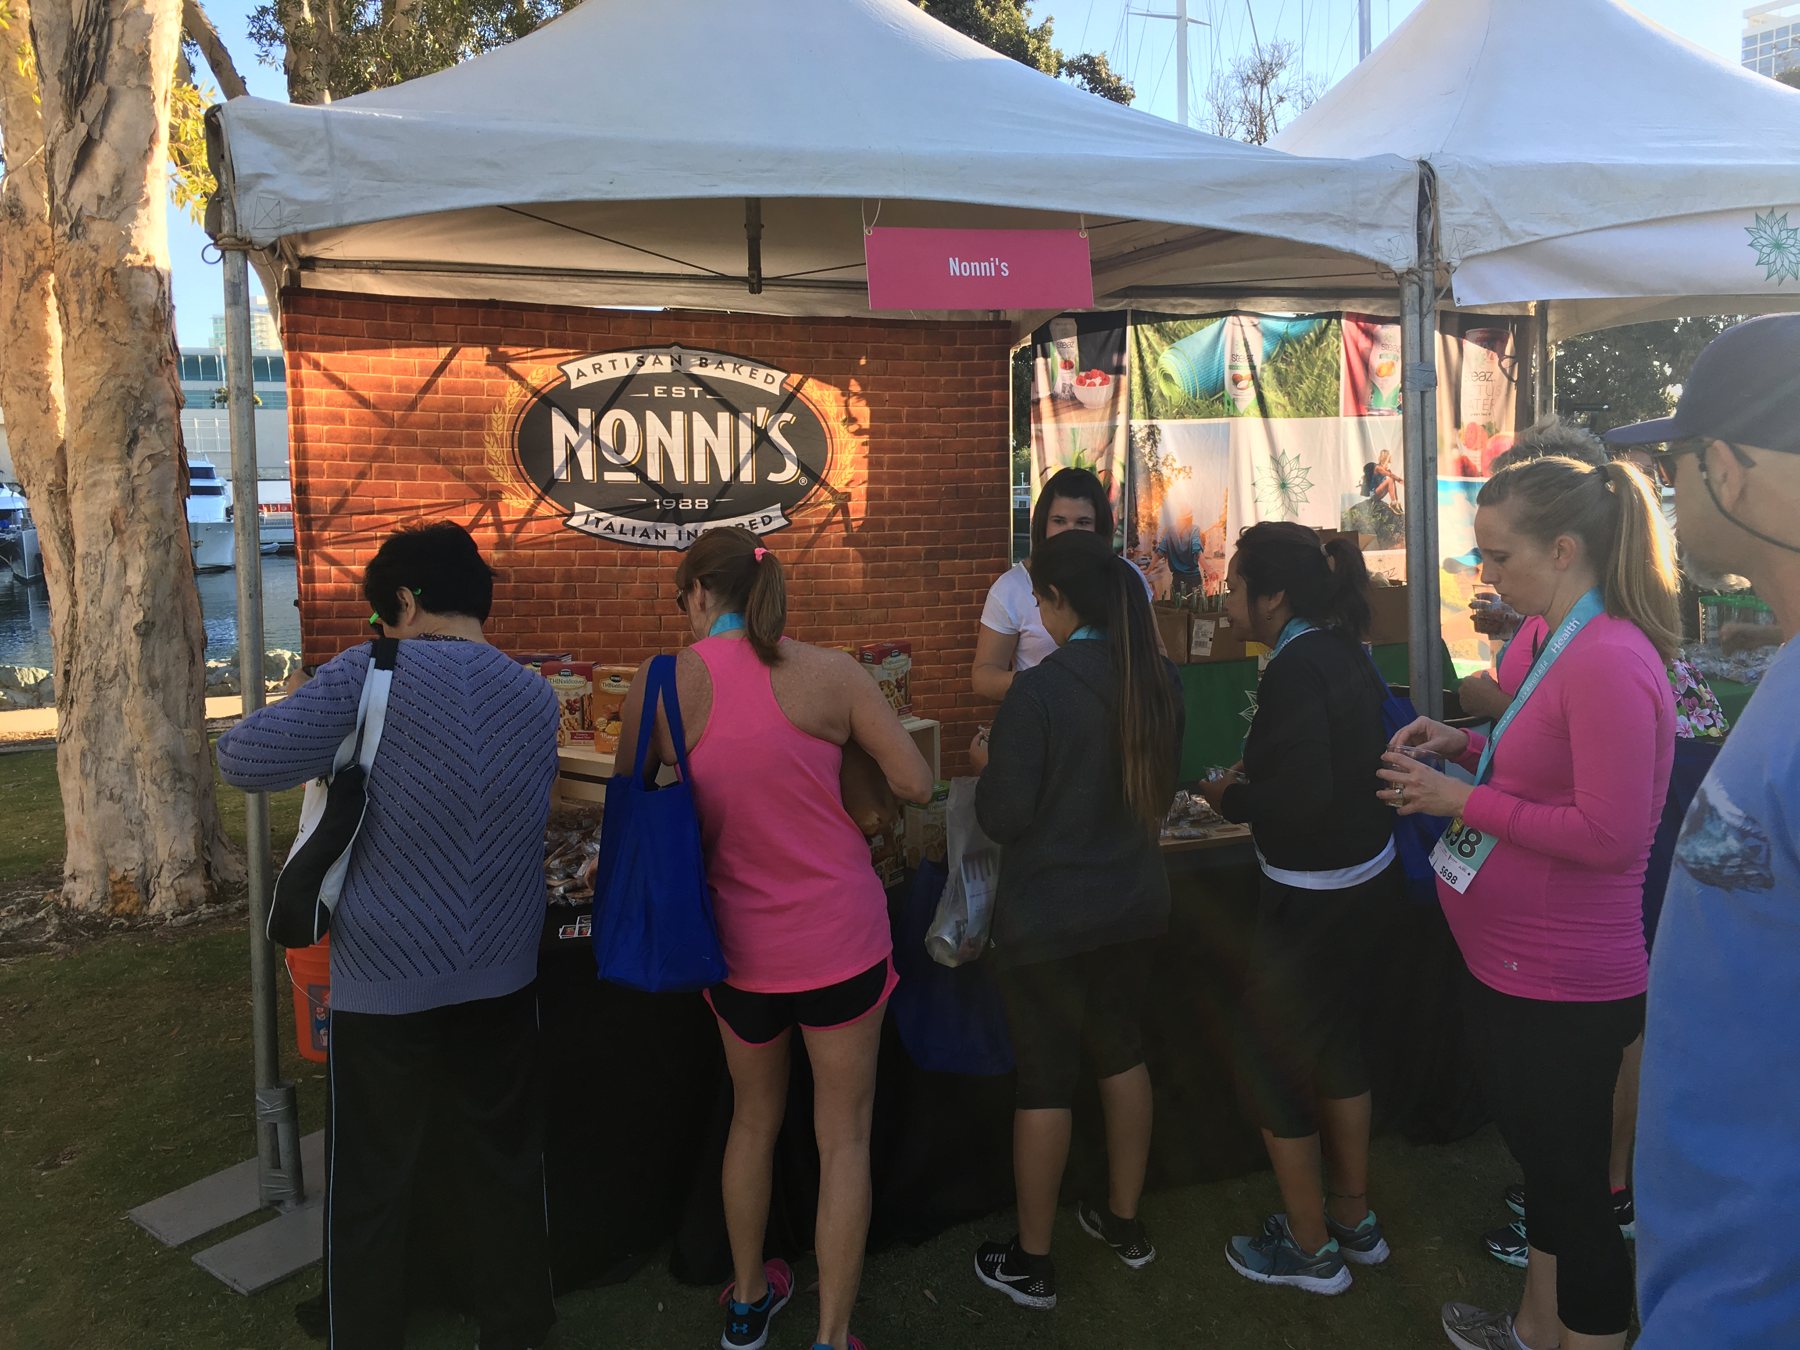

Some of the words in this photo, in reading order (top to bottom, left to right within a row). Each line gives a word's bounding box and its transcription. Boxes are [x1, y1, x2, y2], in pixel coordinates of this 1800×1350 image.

[949, 257, 1009, 276] Nonni's
[576, 355, 682, 380] ARTISAN
[699, 356, 775, 385] BAKED
[654, 499, 709, 510] 1988
[584, 514, 667, 540] ITALIAN
[1551, 618, 1580, 654] Health
[1440, 866, 1458, 885] 5698
